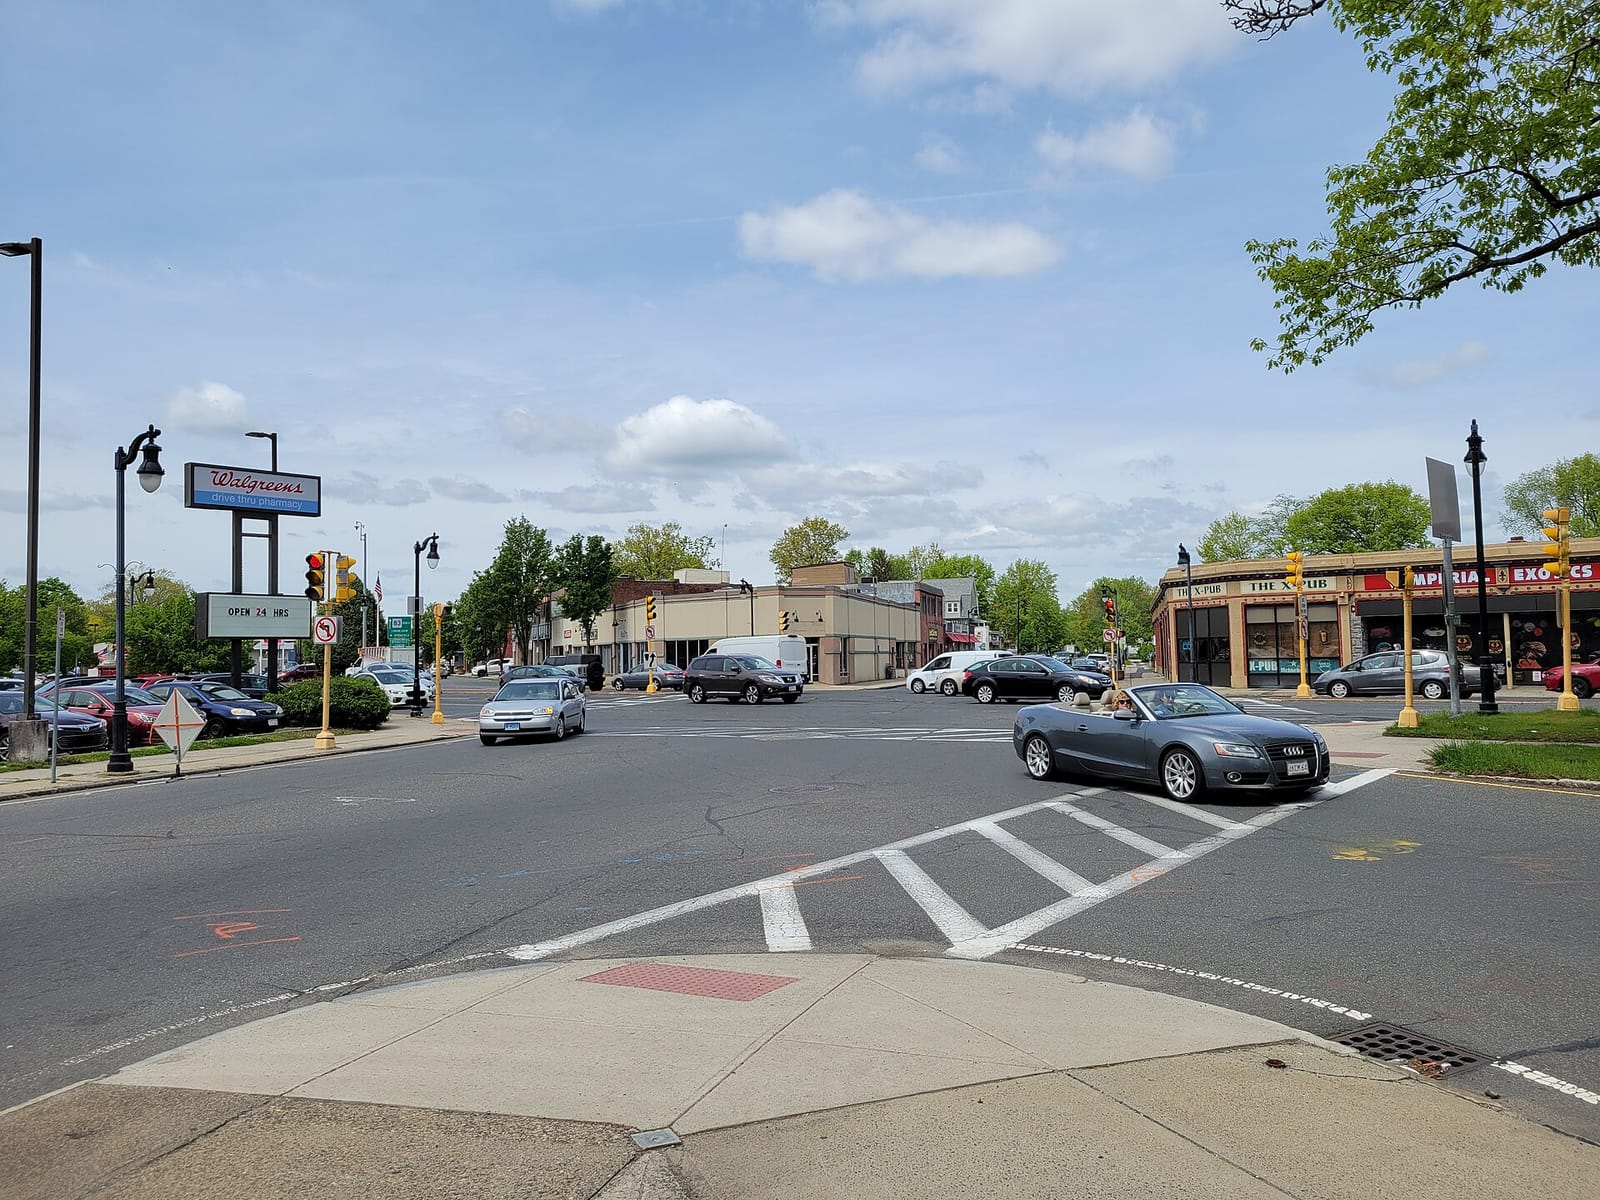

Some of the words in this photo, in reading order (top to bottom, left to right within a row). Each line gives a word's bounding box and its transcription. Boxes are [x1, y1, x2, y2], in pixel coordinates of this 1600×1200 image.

[210, 470, 304, 494] Walgreens
[212, 493, 236, 503] drive
[238, 495, 256, 505] thru
[259, 496, 303, 509] pharmacy
[1412, 570, 1491, 586] MPRIA
[1513, 564, 1593, 581] EXOCS
[1194, 584, 1221, 596] X-PUB
[1249, 581, 1276, 591] THE
[228, 607, 251, 617] OPEN
[255, 608, 267, 617] 24
[273, 608, 289, 618] HRS
[1249, 661, 1278, 672] X-PUB
